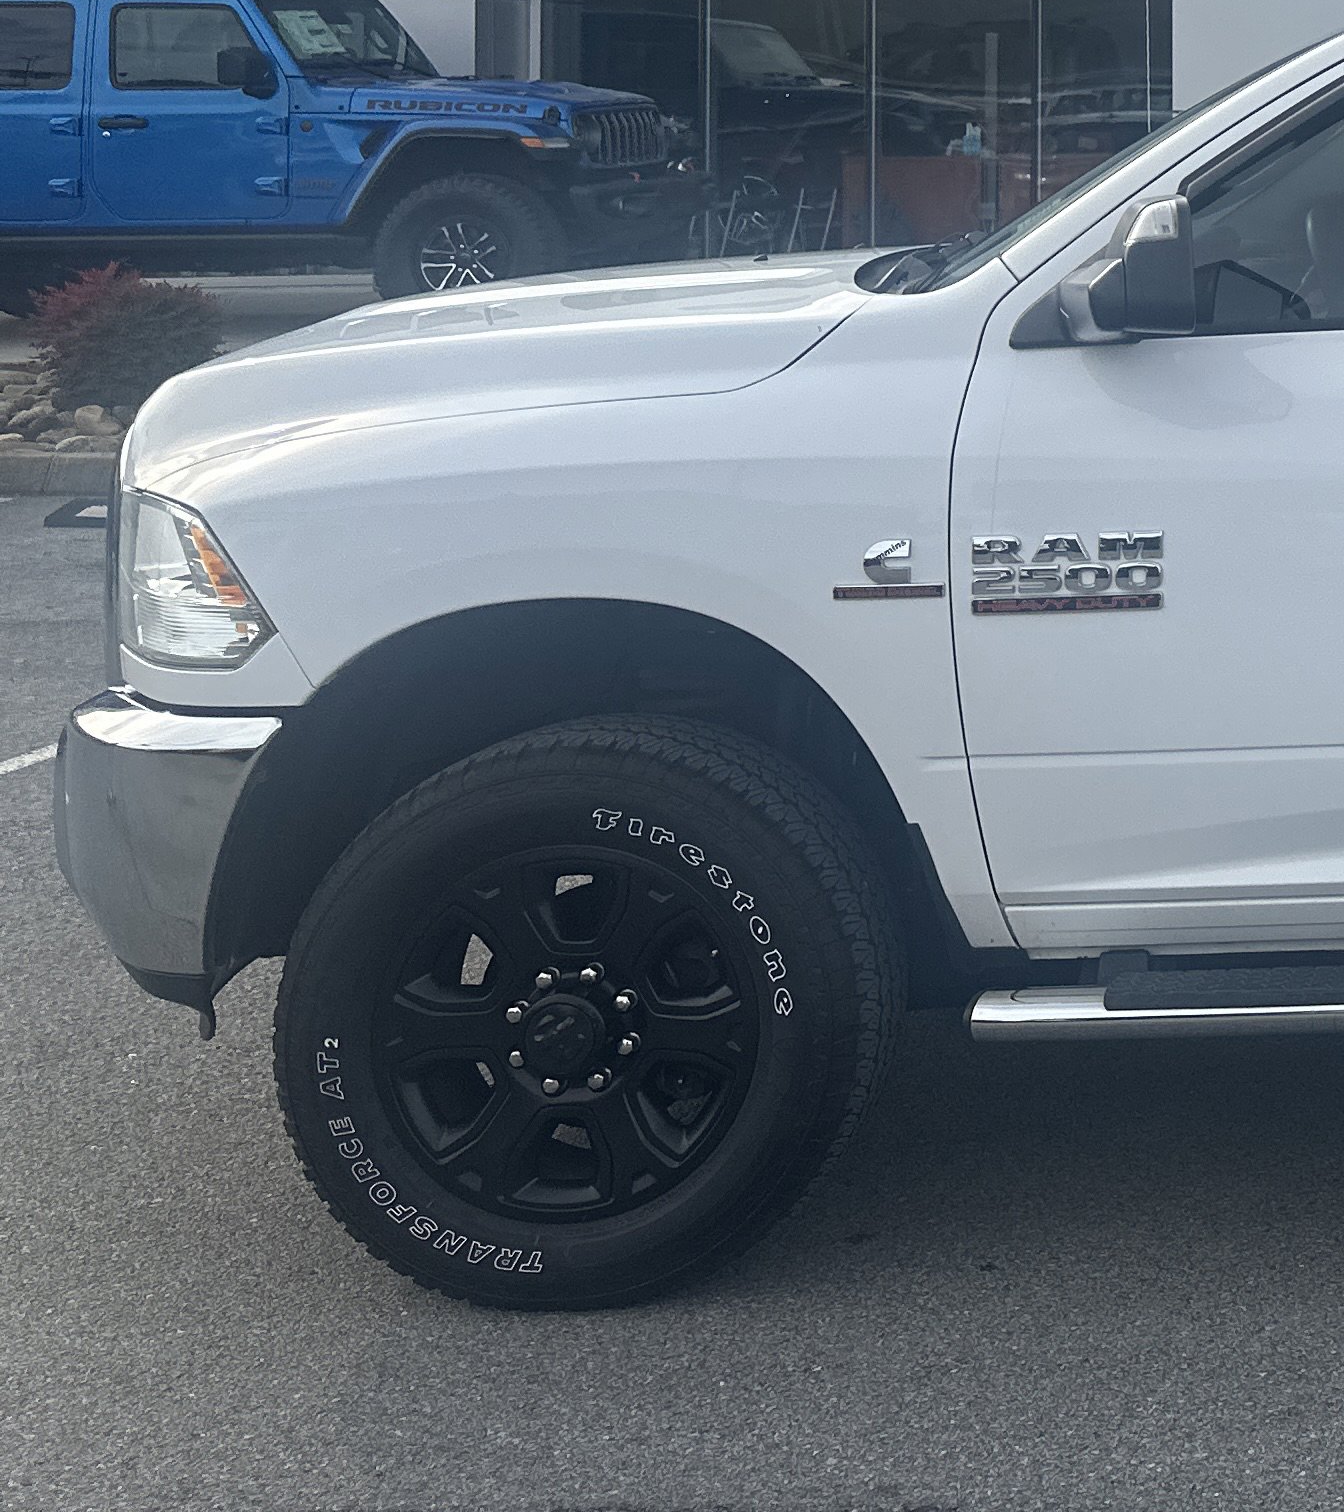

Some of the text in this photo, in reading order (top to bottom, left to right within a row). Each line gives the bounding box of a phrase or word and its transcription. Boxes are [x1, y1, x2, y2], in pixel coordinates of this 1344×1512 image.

[366, 99, 528, 115] RUBICON
[972, 529, 1164, 565] RAM
[972, 561, 1164, 595] 2500
[977, 594, 1155, 613] HEAVY DUTY
[592, 807, 793, 1016] Firestone
[328, 1115, 544, 1274] TRANSFORCE
